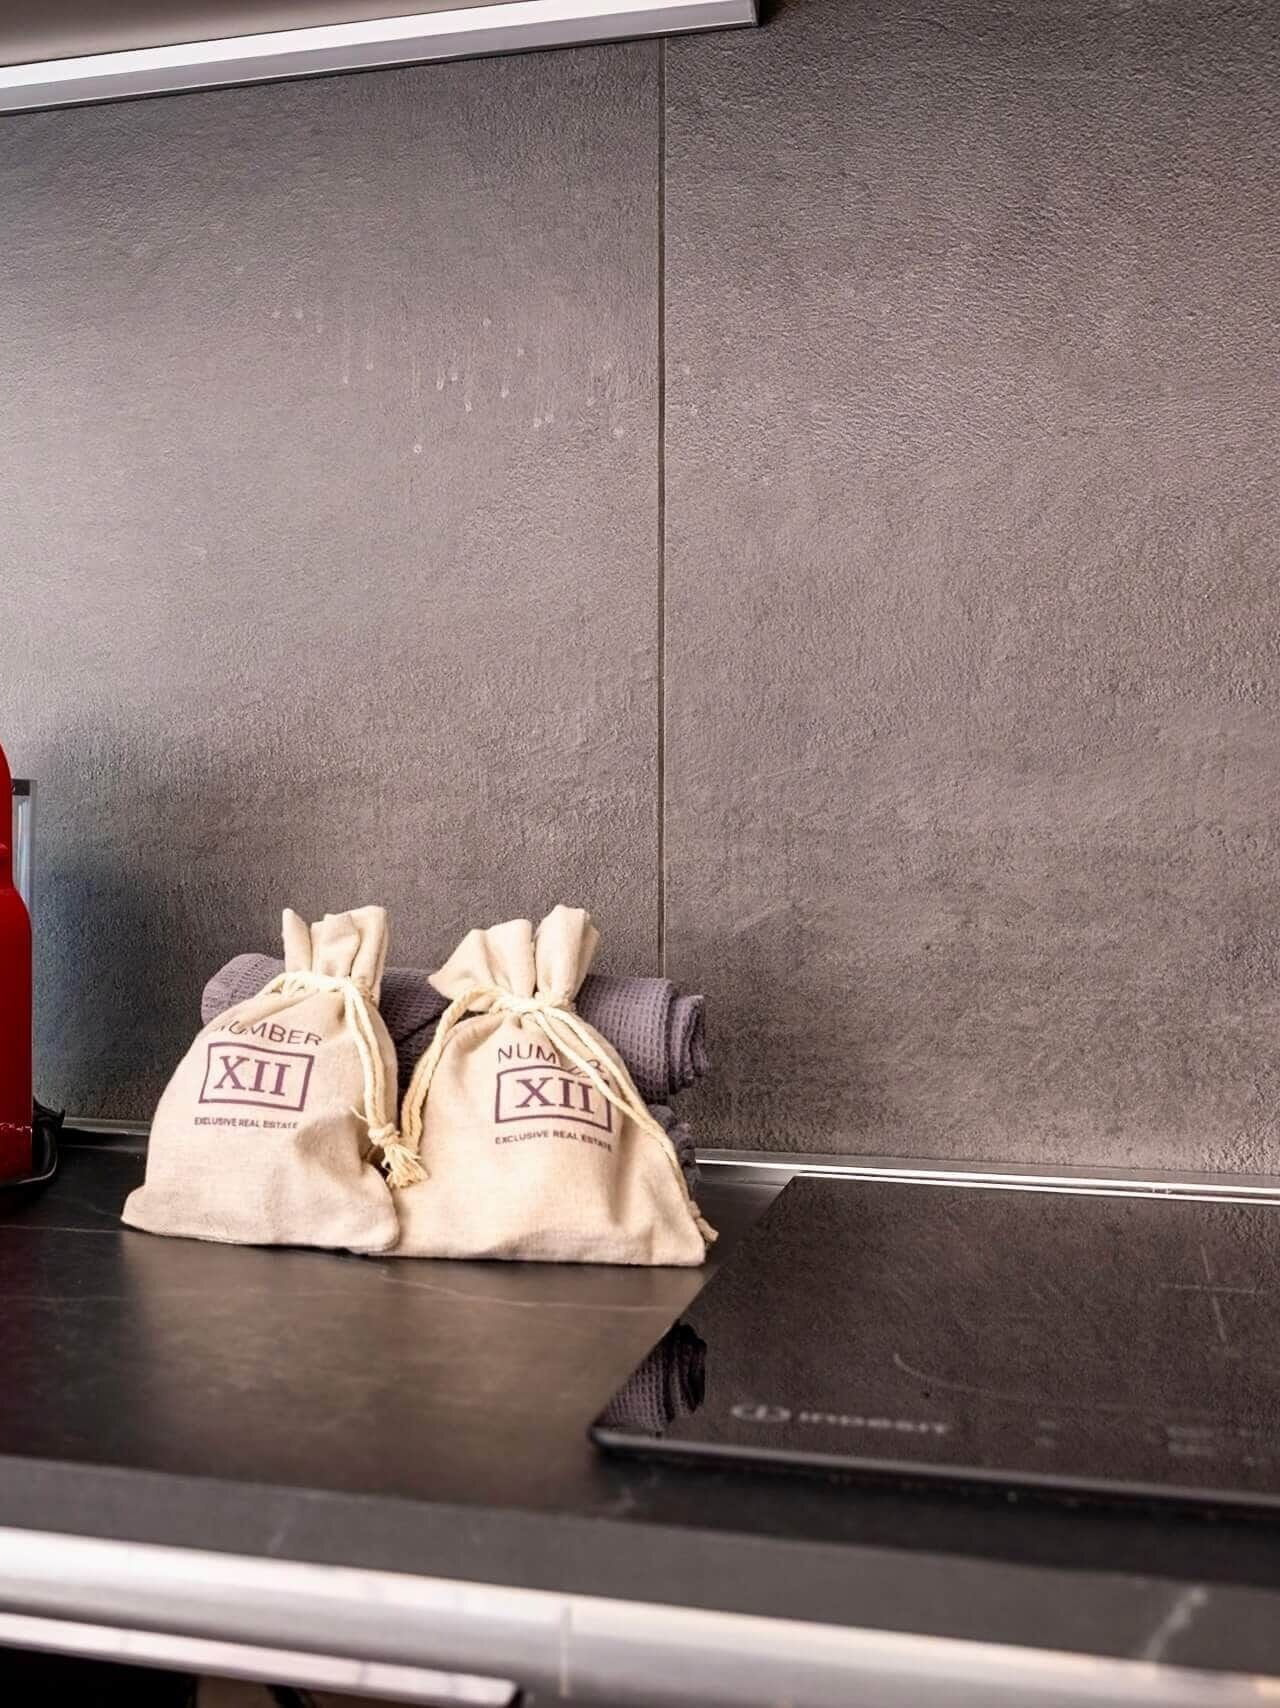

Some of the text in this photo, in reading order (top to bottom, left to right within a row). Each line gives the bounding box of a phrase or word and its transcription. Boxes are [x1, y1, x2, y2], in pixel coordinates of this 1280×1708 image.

[219, 1020, 323, 1046] UMBER
[213, 1055, 291, 1097] XII
[515, 1077, 595, 1114] XII
[194, 1116, 299, 1129] EXCLUSIVE REAL ESTATE
[495, 1130, 612, 1153] EXCLUSIVE REAL ESTATE
